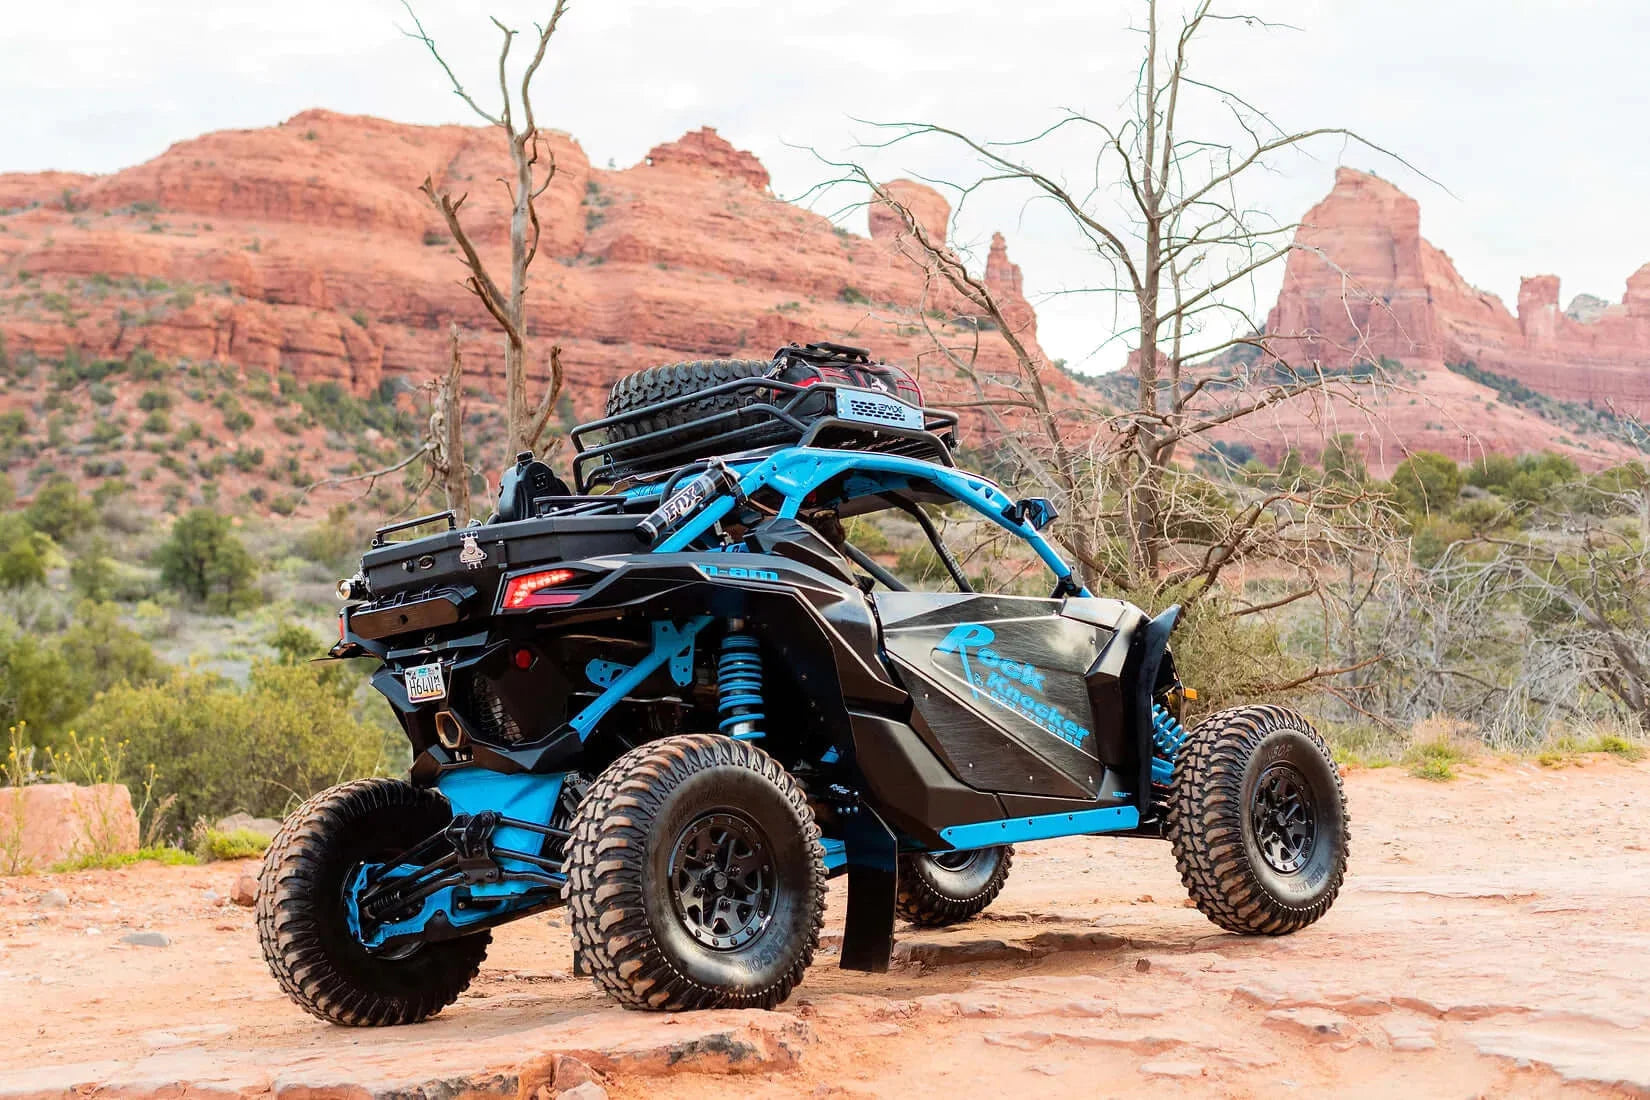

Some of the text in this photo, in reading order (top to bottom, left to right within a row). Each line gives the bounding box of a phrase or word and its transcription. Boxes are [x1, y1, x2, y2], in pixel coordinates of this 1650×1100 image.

[664, 486, 703, 521] FOX
[935, 621, 1046, 700] Rock
[985, 671, 1090, 740] Knocker
